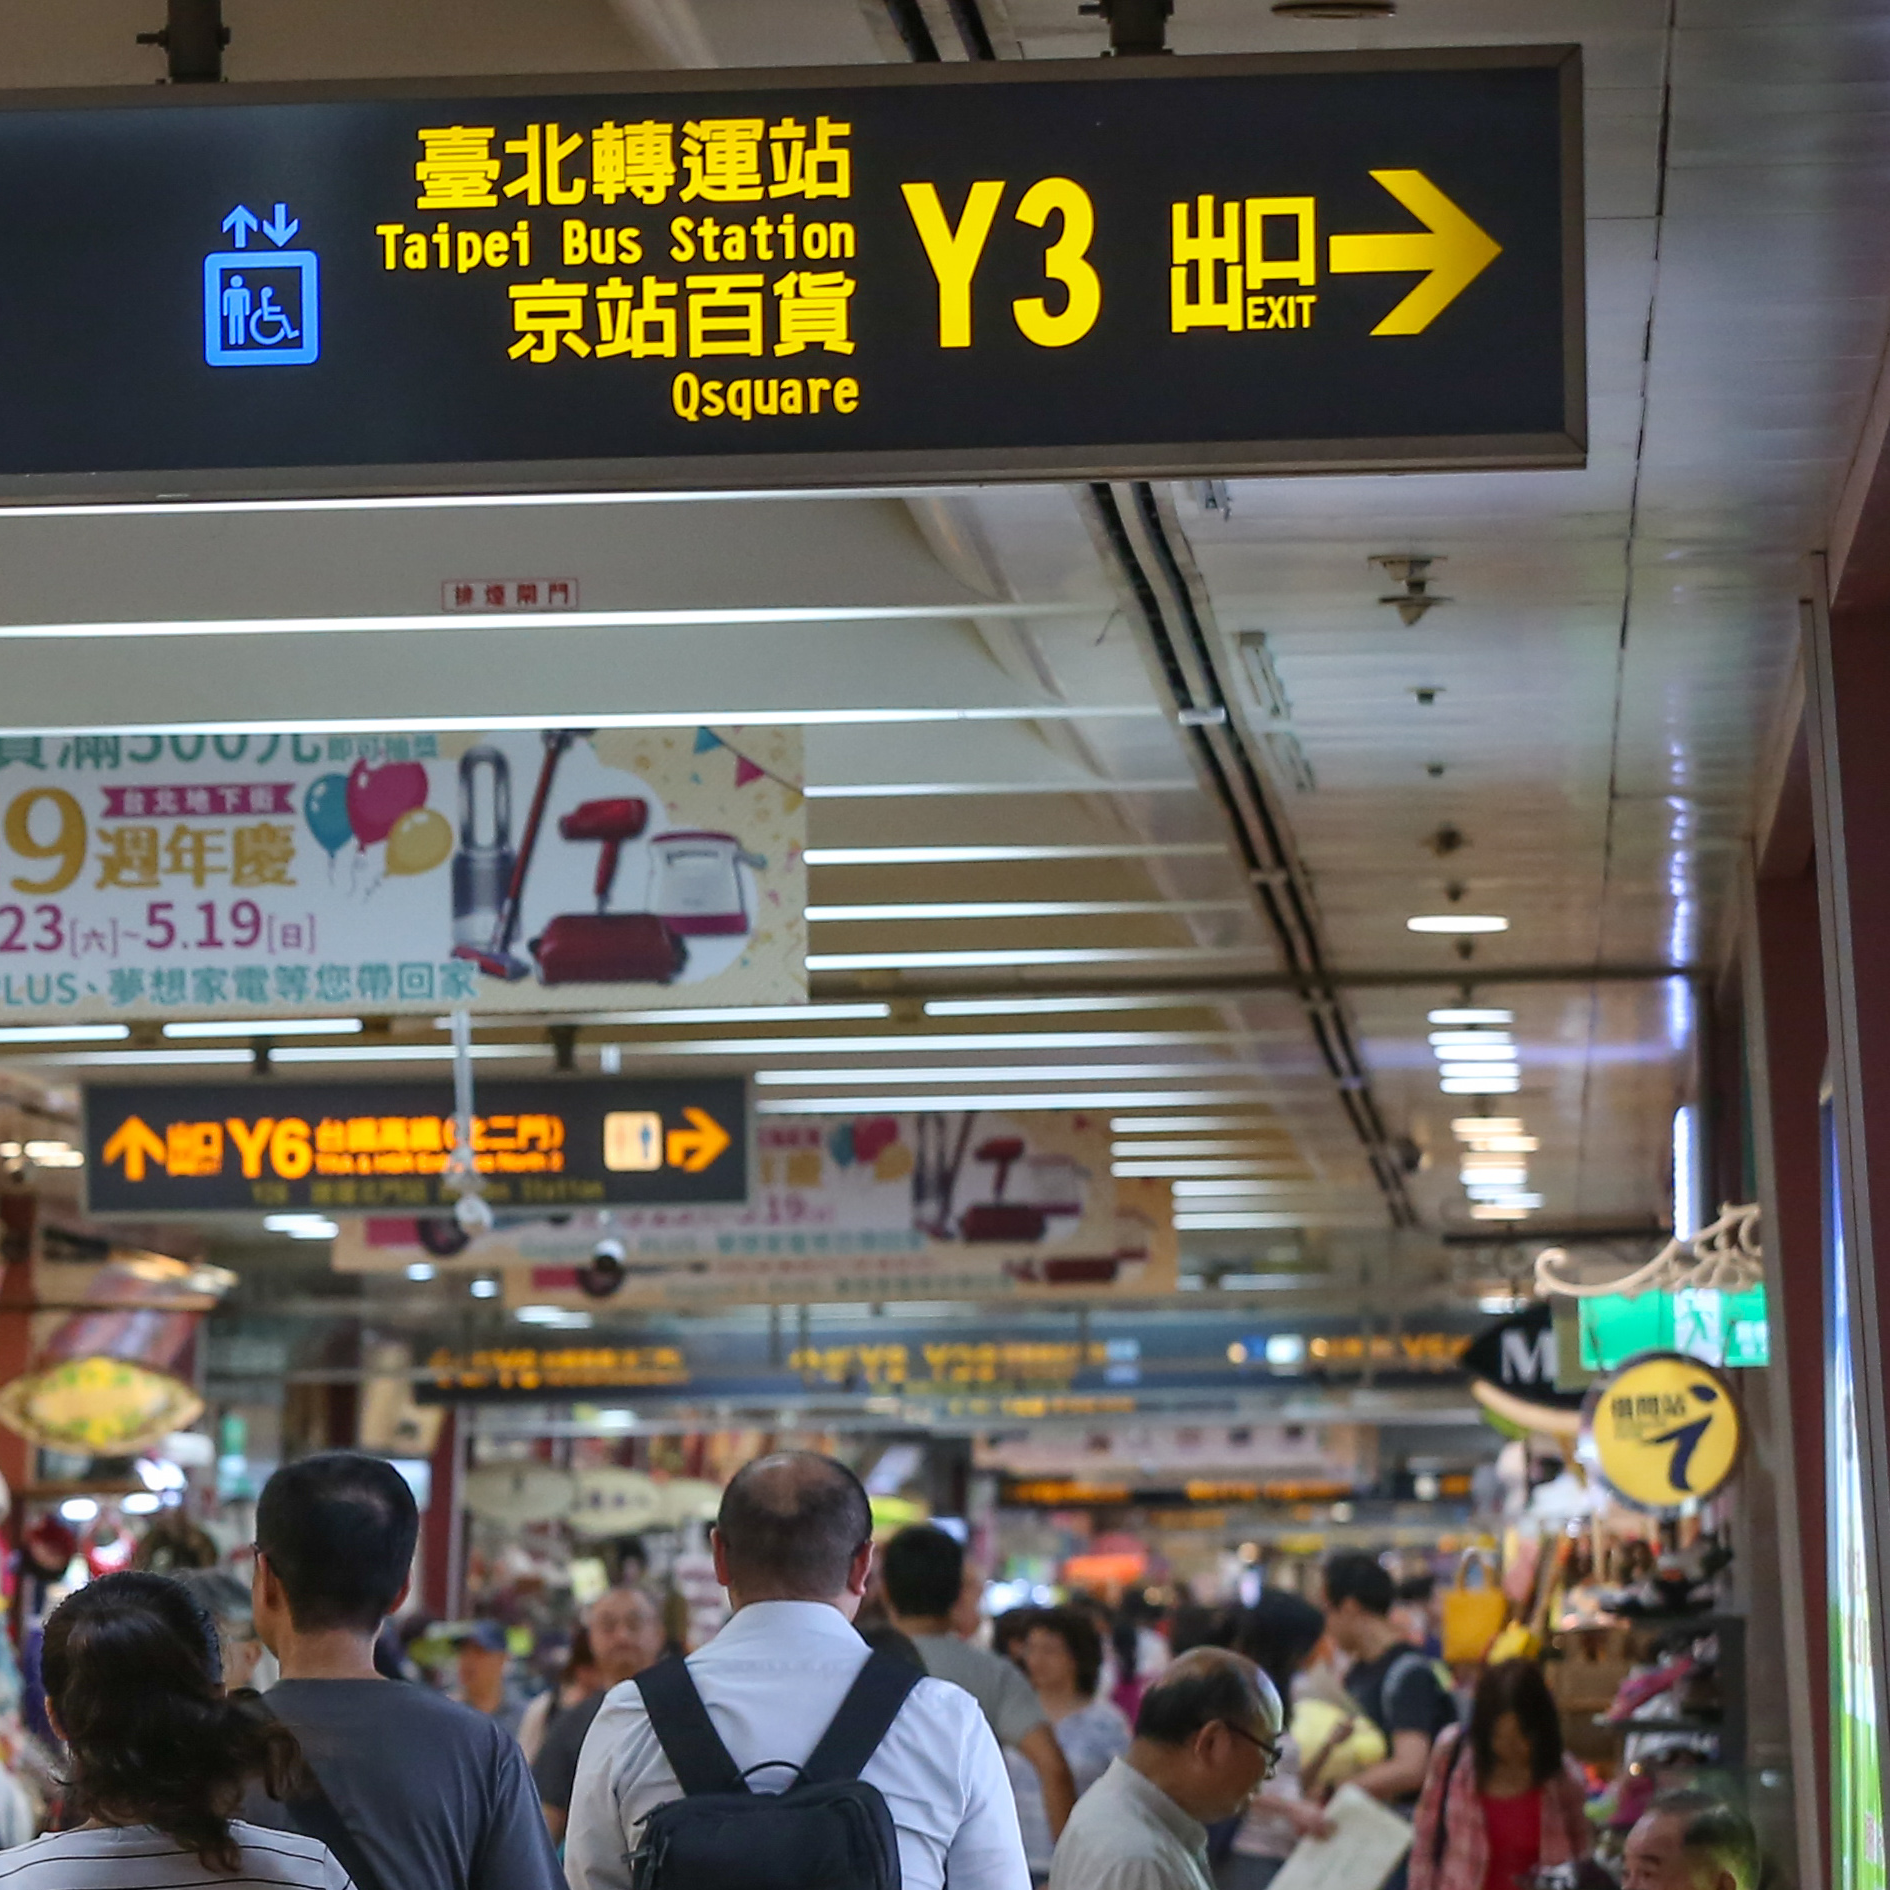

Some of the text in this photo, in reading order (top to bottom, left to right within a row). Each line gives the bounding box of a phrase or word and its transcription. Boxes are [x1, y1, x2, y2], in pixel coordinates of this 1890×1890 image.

[416, 116, 850, 209] 臺北轉運站
[376, 214, 854, 273] Taipei Bus Station
[901, 178, 1100, 347] Y3
[1171, 195, 1317, 332] 出口
[508, 271, 856, 362] 京站百貨
[1247, 295, 1317, 329] EXIT
[673, 372, 858, 421] Qsquare
[95, 822, 297, 890] 週年慶
[225, 1117, 313, 1179] Y6
